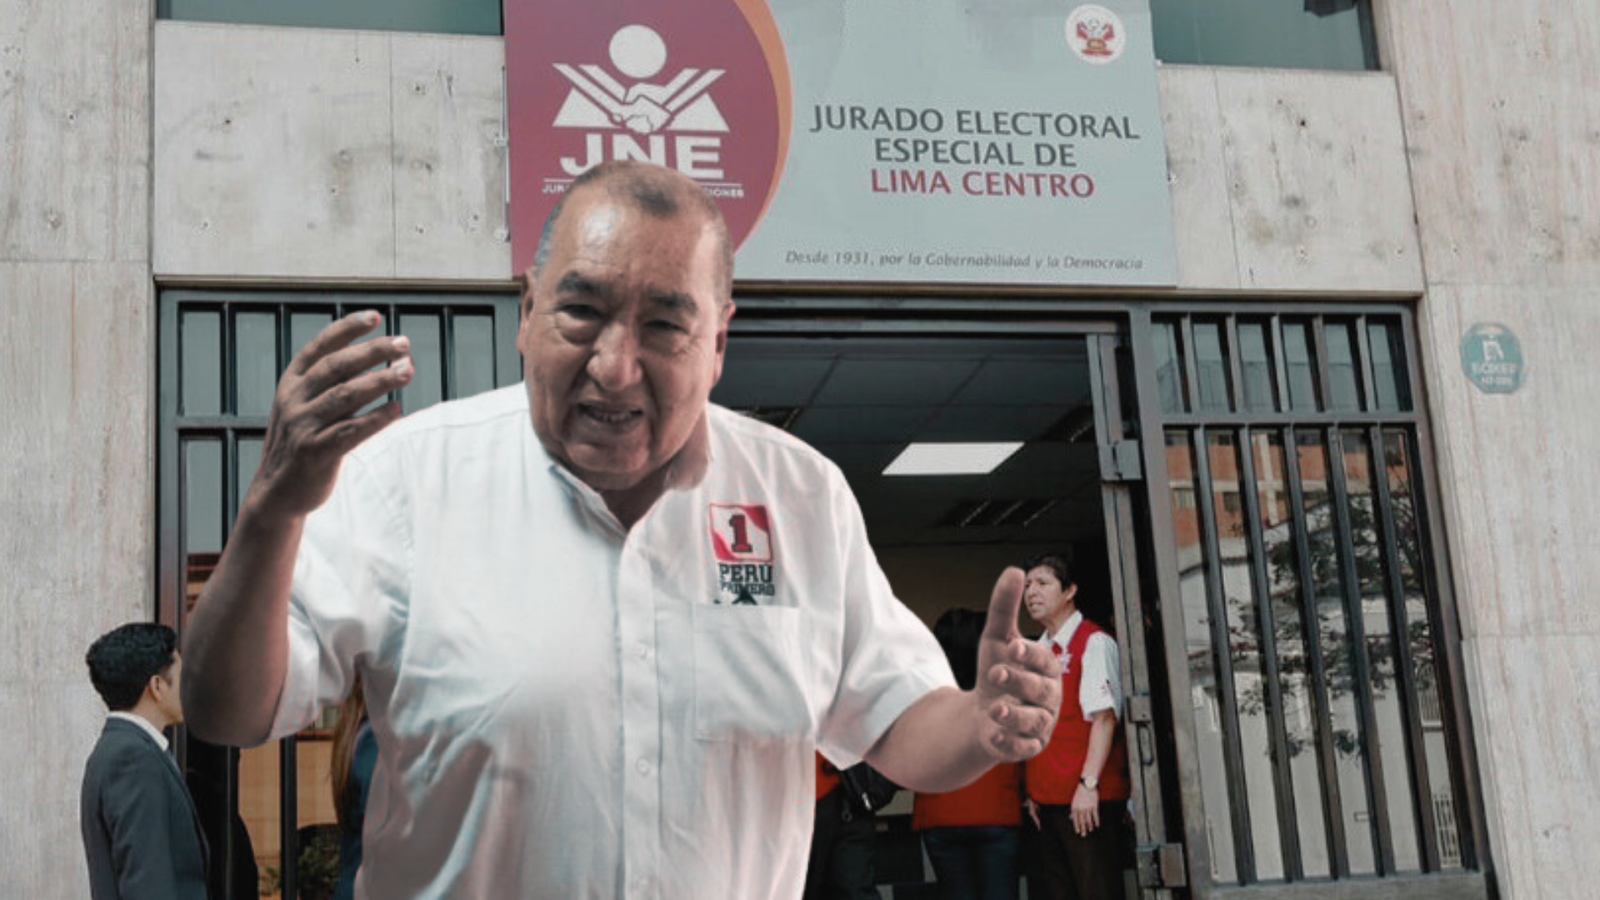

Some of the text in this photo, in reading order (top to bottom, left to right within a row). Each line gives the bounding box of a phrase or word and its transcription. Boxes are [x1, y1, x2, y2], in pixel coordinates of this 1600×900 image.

[809, 104, 1141, 140] JURADO ELECTORAL
[559, 133, 724, 179] JNE
[874, 137, 1077, 168] ESPECIAL DE
[541, 183, 570, 194] JUR
[871, 168, 1095, 198] LIMA CENTRO
[786, 250, 1143, 270] Desde 1931, por la Gobernabilidad y la Democracia
[729, 514, 753, 553] 1
